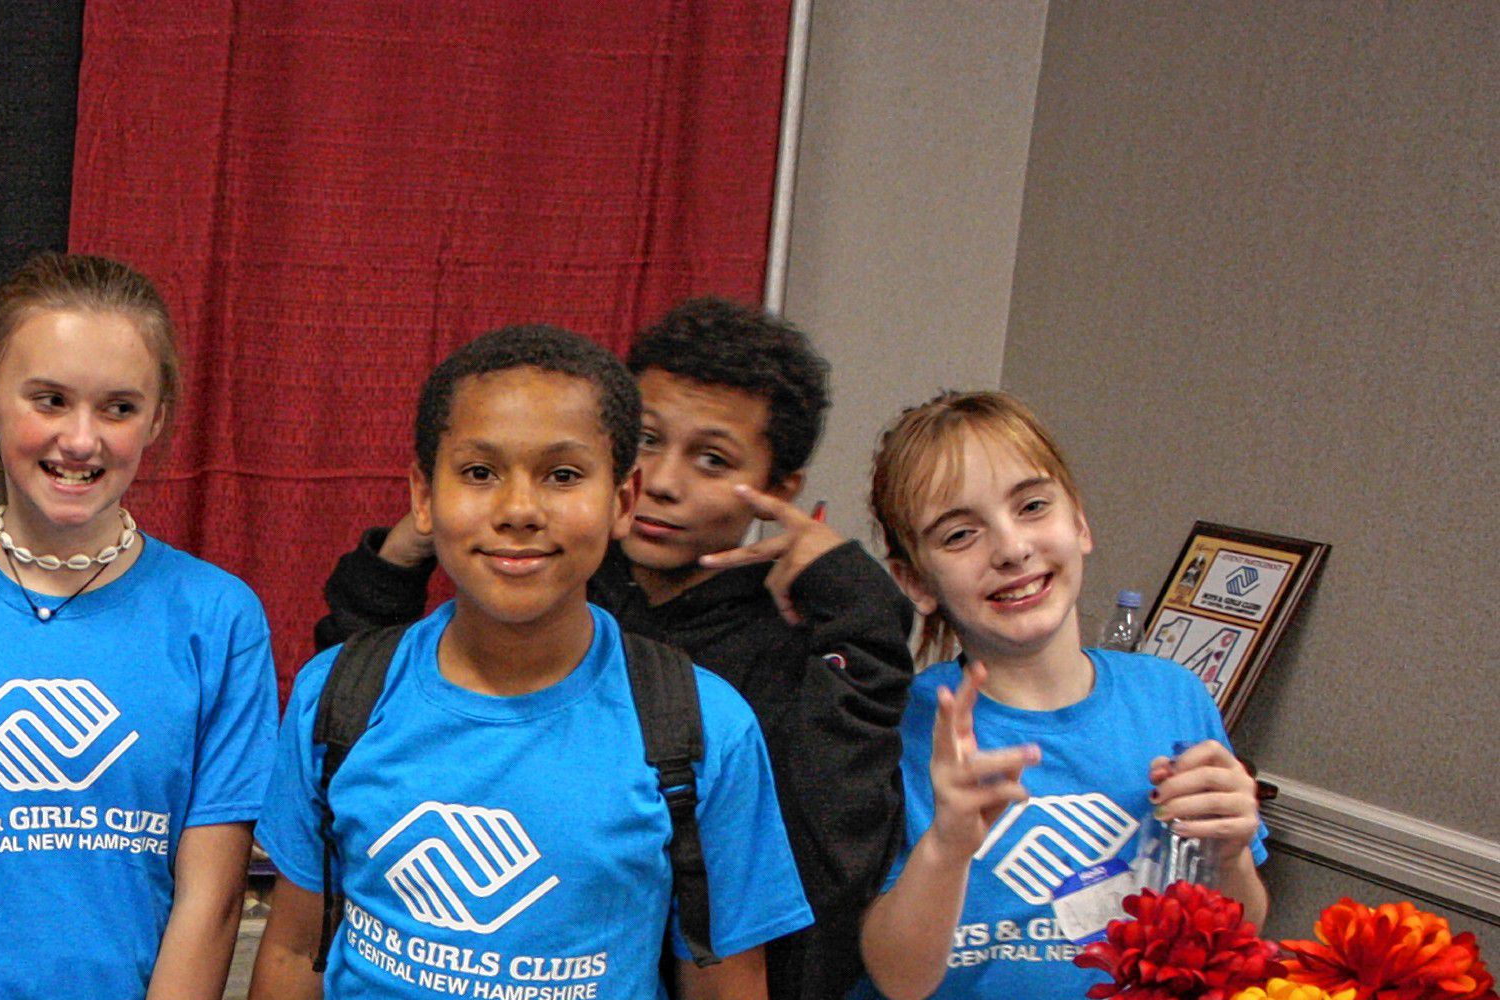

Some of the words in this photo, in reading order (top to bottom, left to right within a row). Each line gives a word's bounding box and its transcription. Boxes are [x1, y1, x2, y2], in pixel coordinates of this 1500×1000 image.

[9, 806, 99, 831] GIRLS
[28, 833, 74, 851] NEW
[995, 920, 1023, 941] &
[385, 927, 402, 955] &
[407, 936, 500, 977] GIRLS
[509, 952, 608, 982] CLUBS
[947, 944, 1042, 968] CENTRAL
[1045, 944, 1085, 962] NE
[358, 938, 416, 984] CENTRAL
[418, 970, 469, 996] NEW
